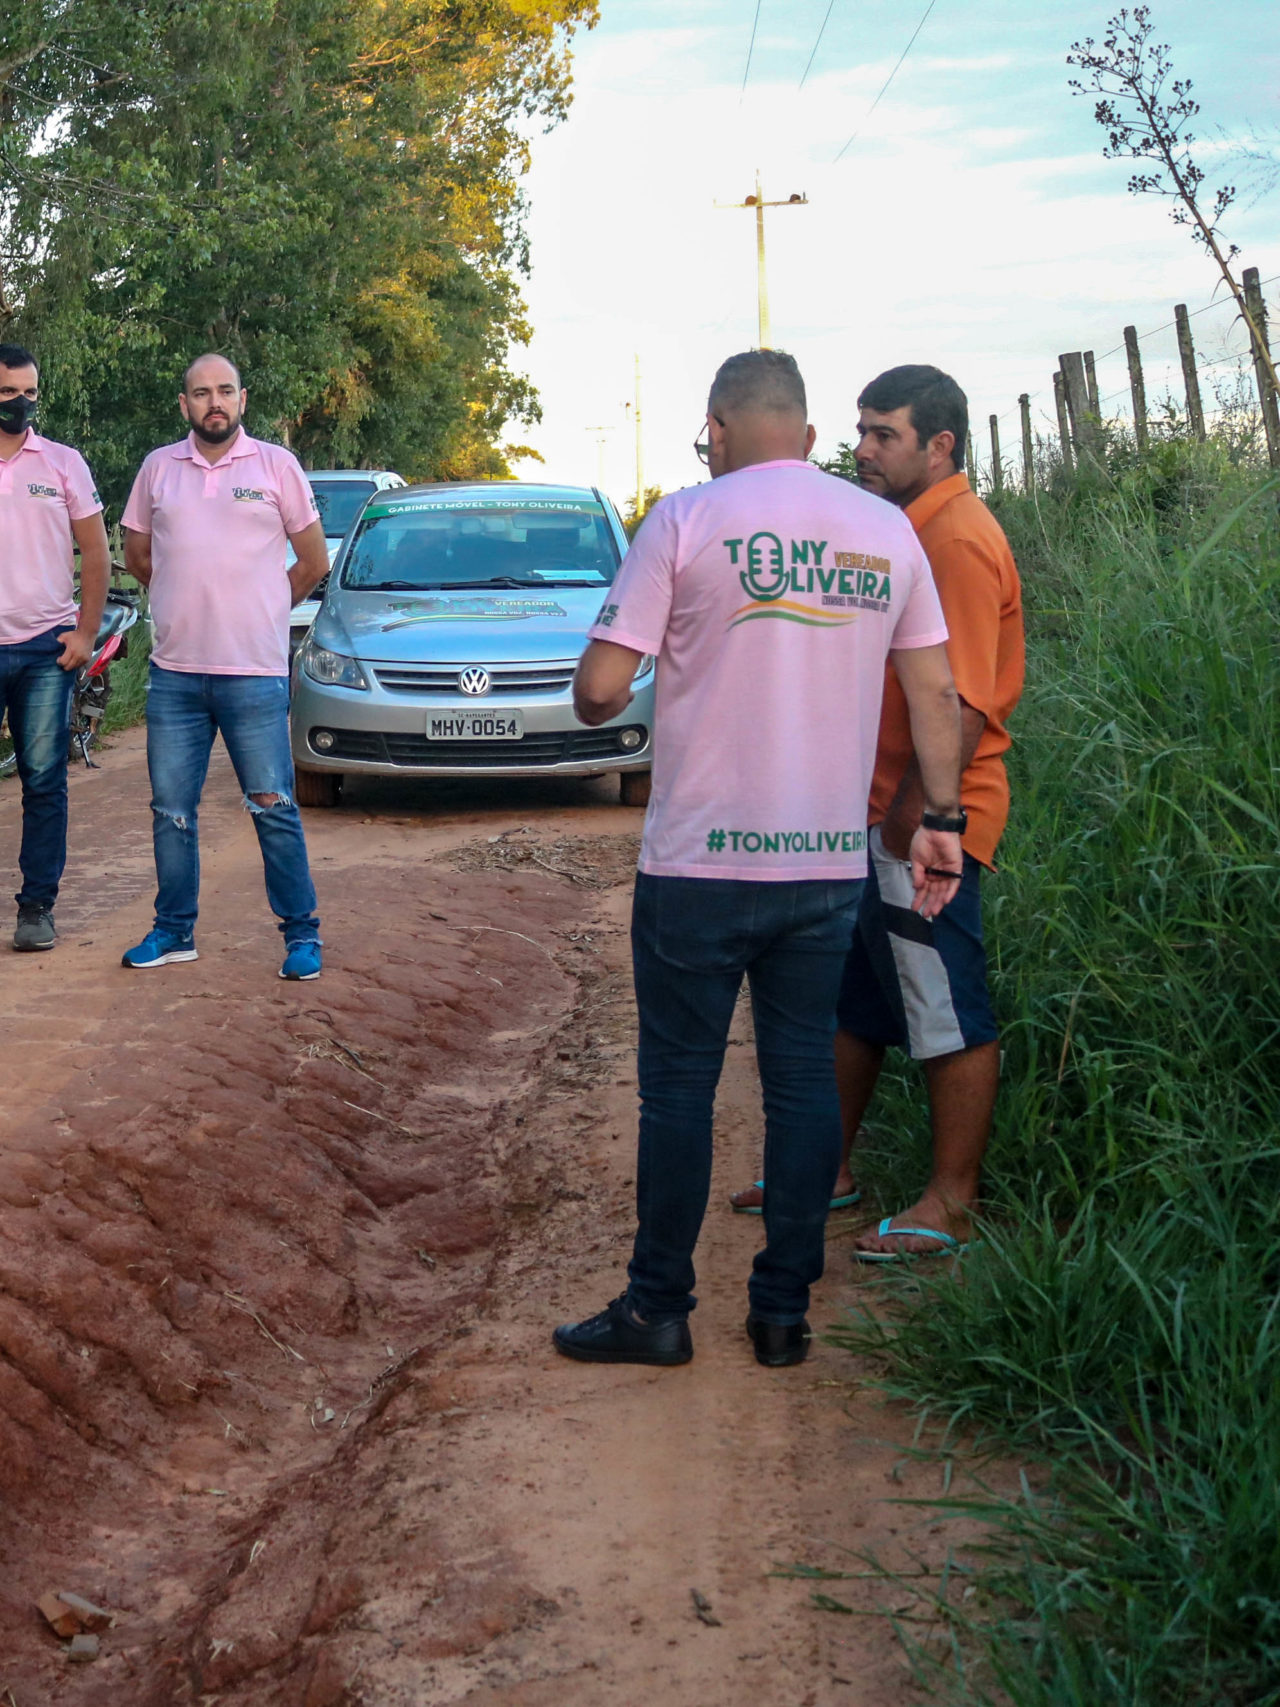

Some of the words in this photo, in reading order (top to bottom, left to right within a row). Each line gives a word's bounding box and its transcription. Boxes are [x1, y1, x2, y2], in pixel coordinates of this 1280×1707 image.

[388, 503, 443, 514] GABINETE
[528, 502, 582, 511] OLIVEIRA
[834, 551, 891, 575] VEREADOR
